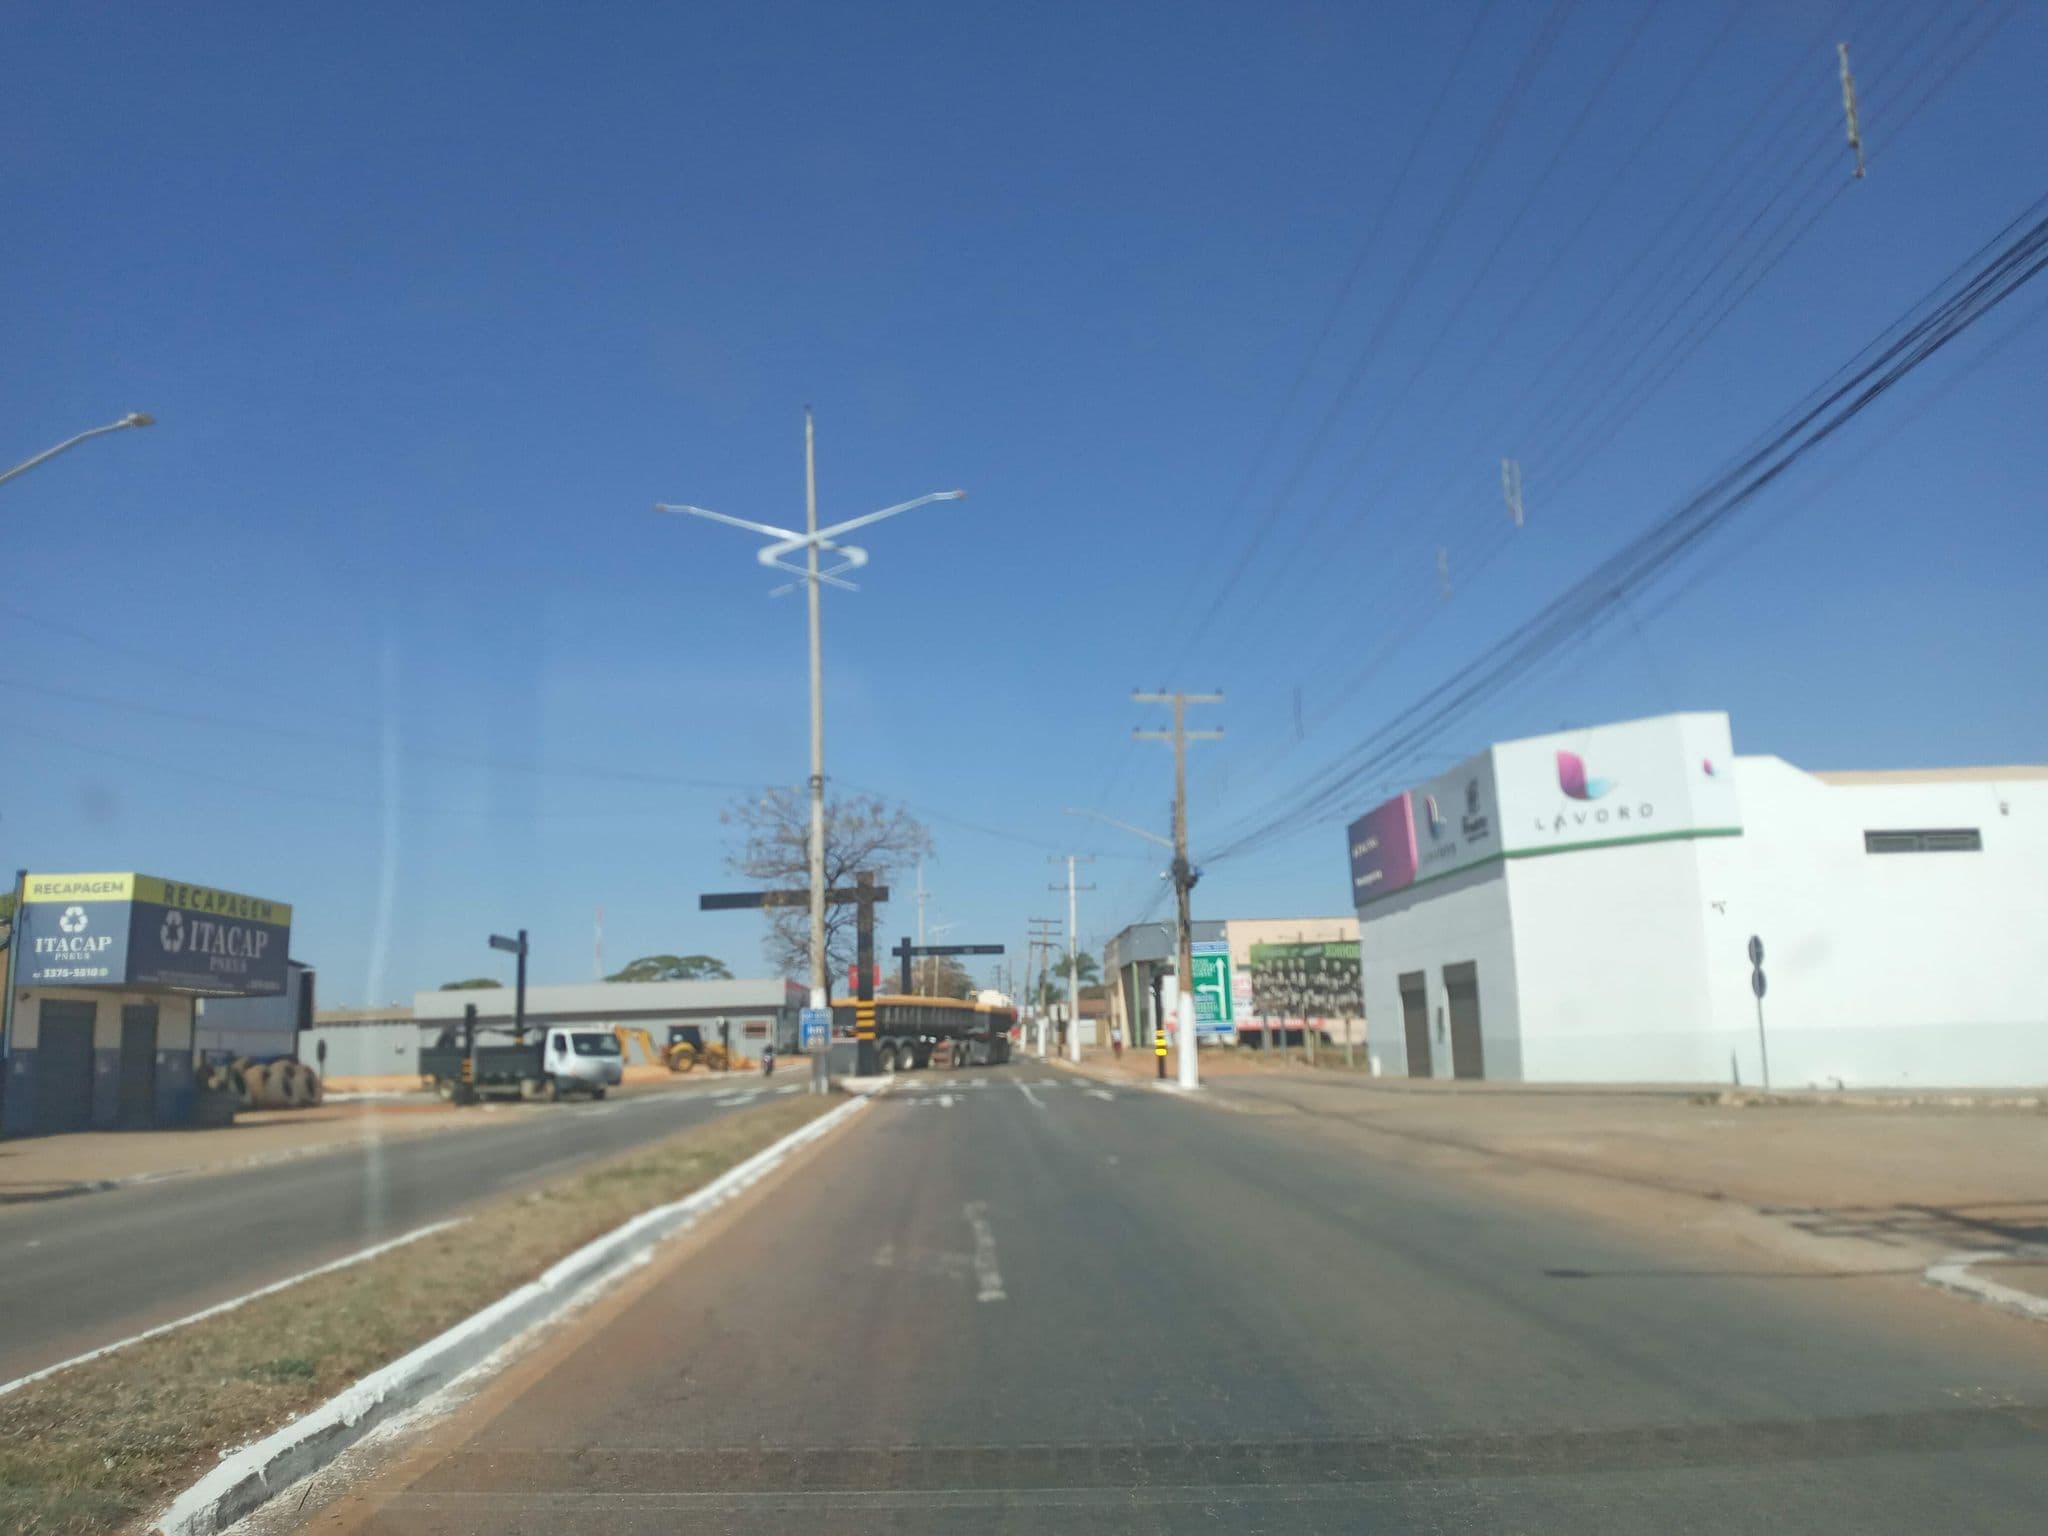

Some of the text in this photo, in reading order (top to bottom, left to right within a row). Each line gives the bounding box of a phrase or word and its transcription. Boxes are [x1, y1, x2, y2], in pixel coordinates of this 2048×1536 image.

[1534, 803, 1654, 833] LAVORO
[33, 882, 124, 895] RECAPAGEM
[164, 882, 273, 919] RECAPAGEM
[35, 936, 112, 953] ITACAP
[188, 919, 268, 959] ITACAP
